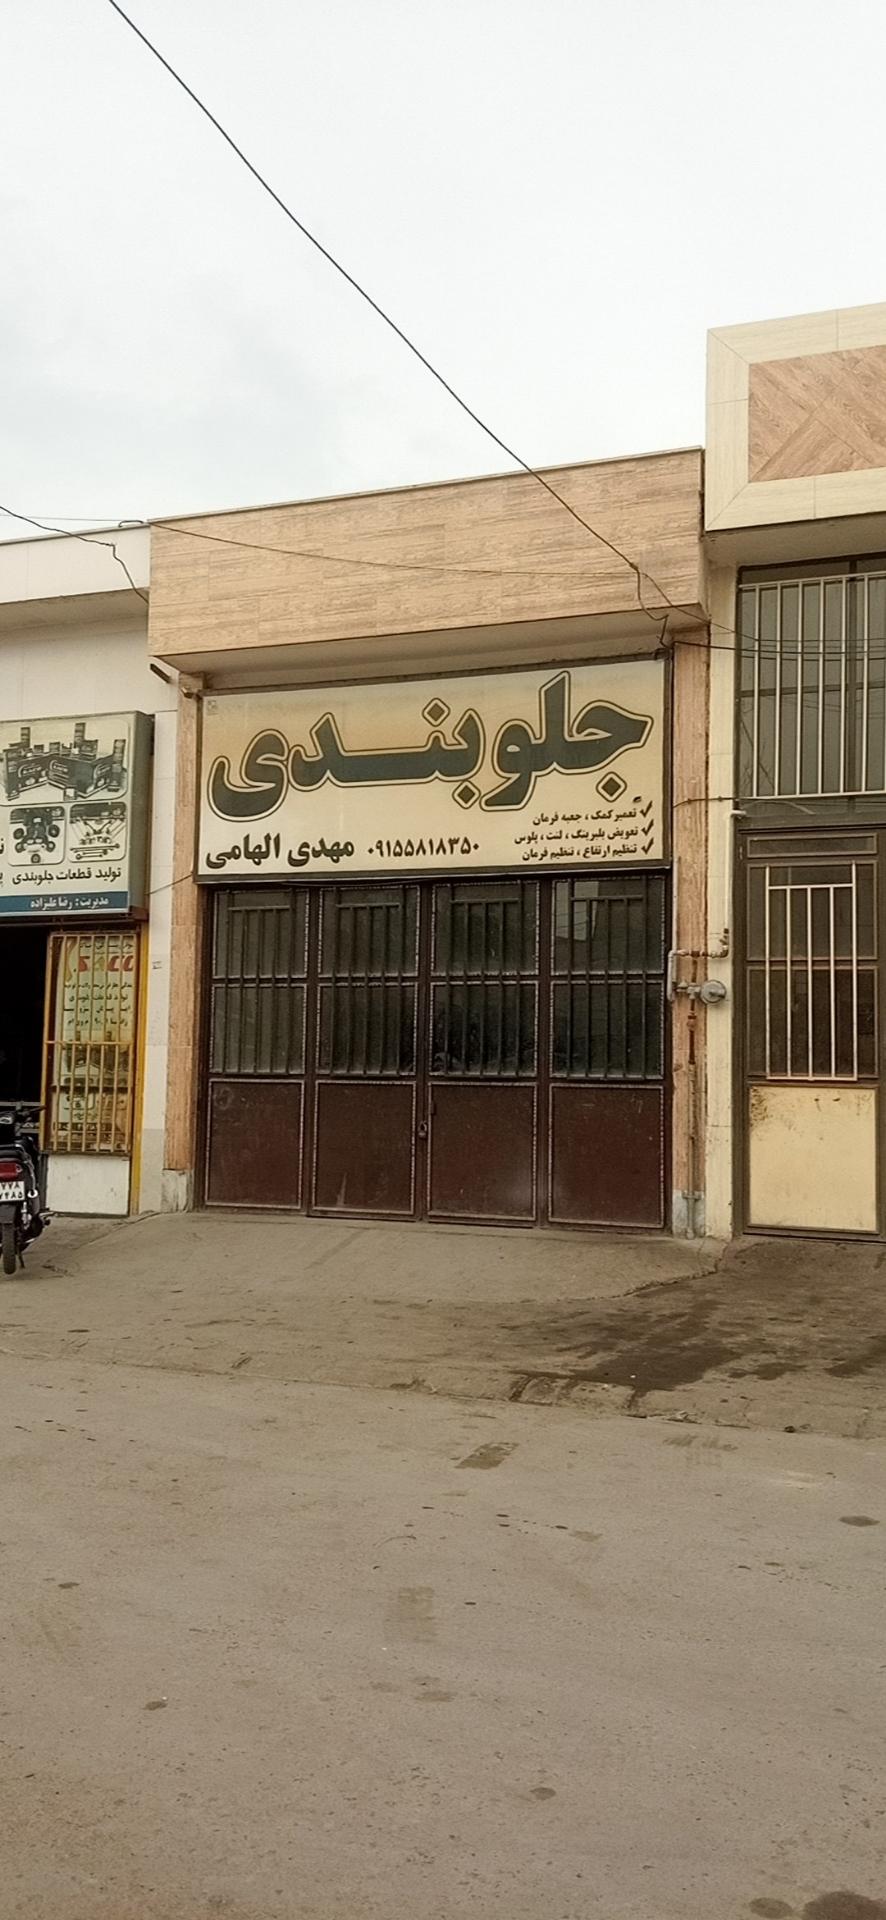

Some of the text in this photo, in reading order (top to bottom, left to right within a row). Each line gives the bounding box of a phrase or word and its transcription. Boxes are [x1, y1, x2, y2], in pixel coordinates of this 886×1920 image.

[207, 671, 655, 822] جلوبندی
[532, 813, 559, 826] فرمان
[561, 813, 582, 824] جعبه
[591, 809, 614, 820] کمک
[615, 807, 637, 822] تعمیر
[514, 833, 538, 845] پلوس
[546, 830, 563, 841] لنت
[571, 827, 606, 842] بلبرینگ
[607, 826, 639, 840] تعویض
[205, 832, 356, 870] مهدی الهامی
[367, 836, 480, 858] ۰۹۱۵۵۸۱۸۳۵۰
[550, 847, 574, 859] تنظیم
[583, 844, 611, 858] ارتفاع
[612, 843, 637, 857] تنظیم
[522, 848, 548, 861] فرمان
[12, 869, 54, 886] جلوبندی
[56, 867, 92, 880] قطعات
[96, 866, 122, 882] تولید
